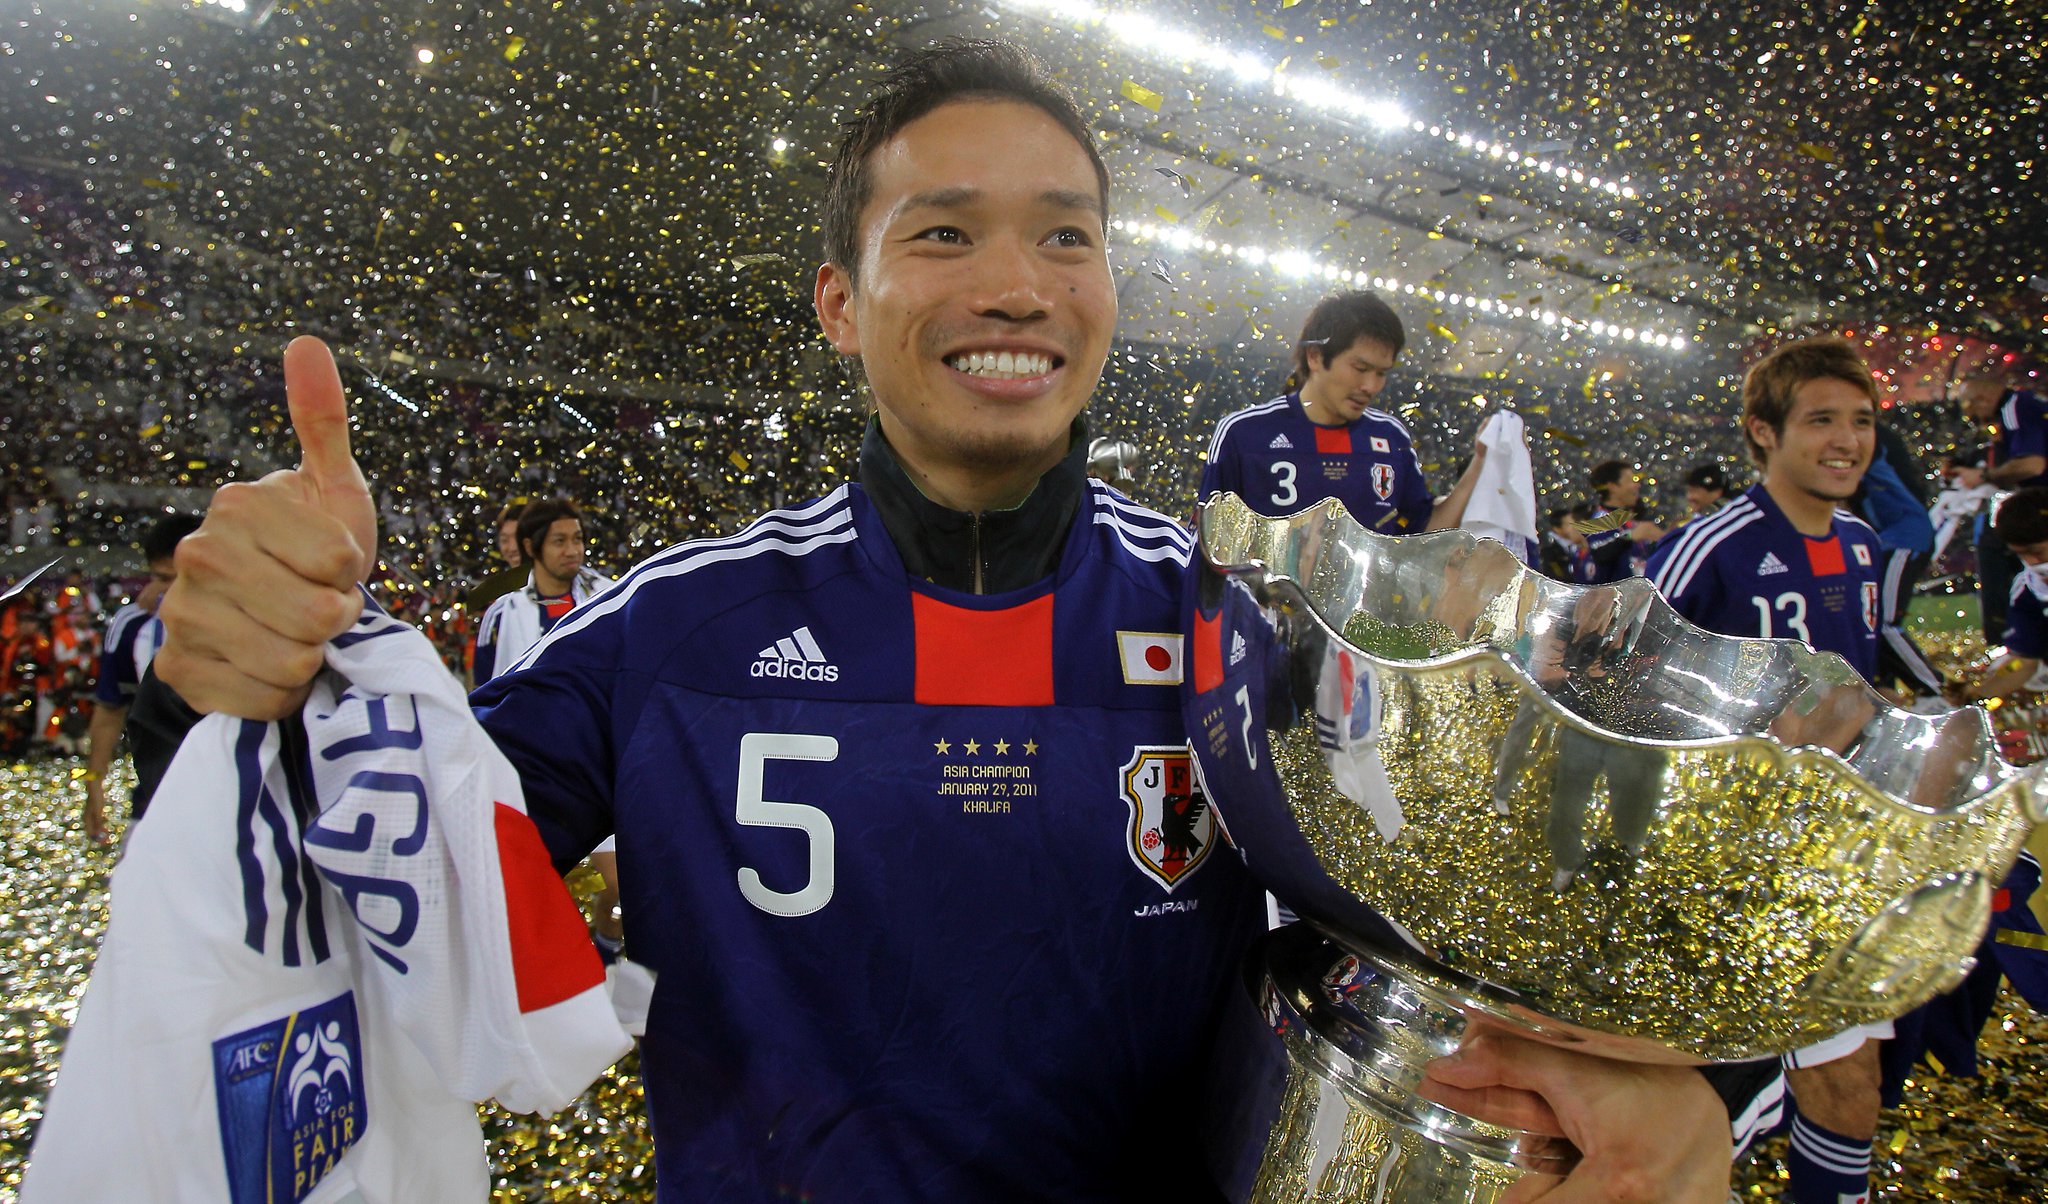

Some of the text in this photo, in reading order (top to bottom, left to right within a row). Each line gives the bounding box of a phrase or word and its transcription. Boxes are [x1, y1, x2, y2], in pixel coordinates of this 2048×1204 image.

[1270, 461, 1298, 507] 3
[1752, 591, 1810, 643] 13
[750, 657, 839, 682] adidas
[943, 765, 1030, 778] ASIA CHAMPION
[1144, 766, 1201, 789] JF
[937, 783, 1037, 797] JANUARY 29, 2011
[963, 801, 1011, 813] KHALIFA
[735, 732, 839, 917] 5
[1134, 899, 1200, 917] JAPAN
[228, 1041, 271, 1076] AFC
[293, 1101, 355, 1142] ASIA FOR
[293, 1117, 355, 1171] FAIR
